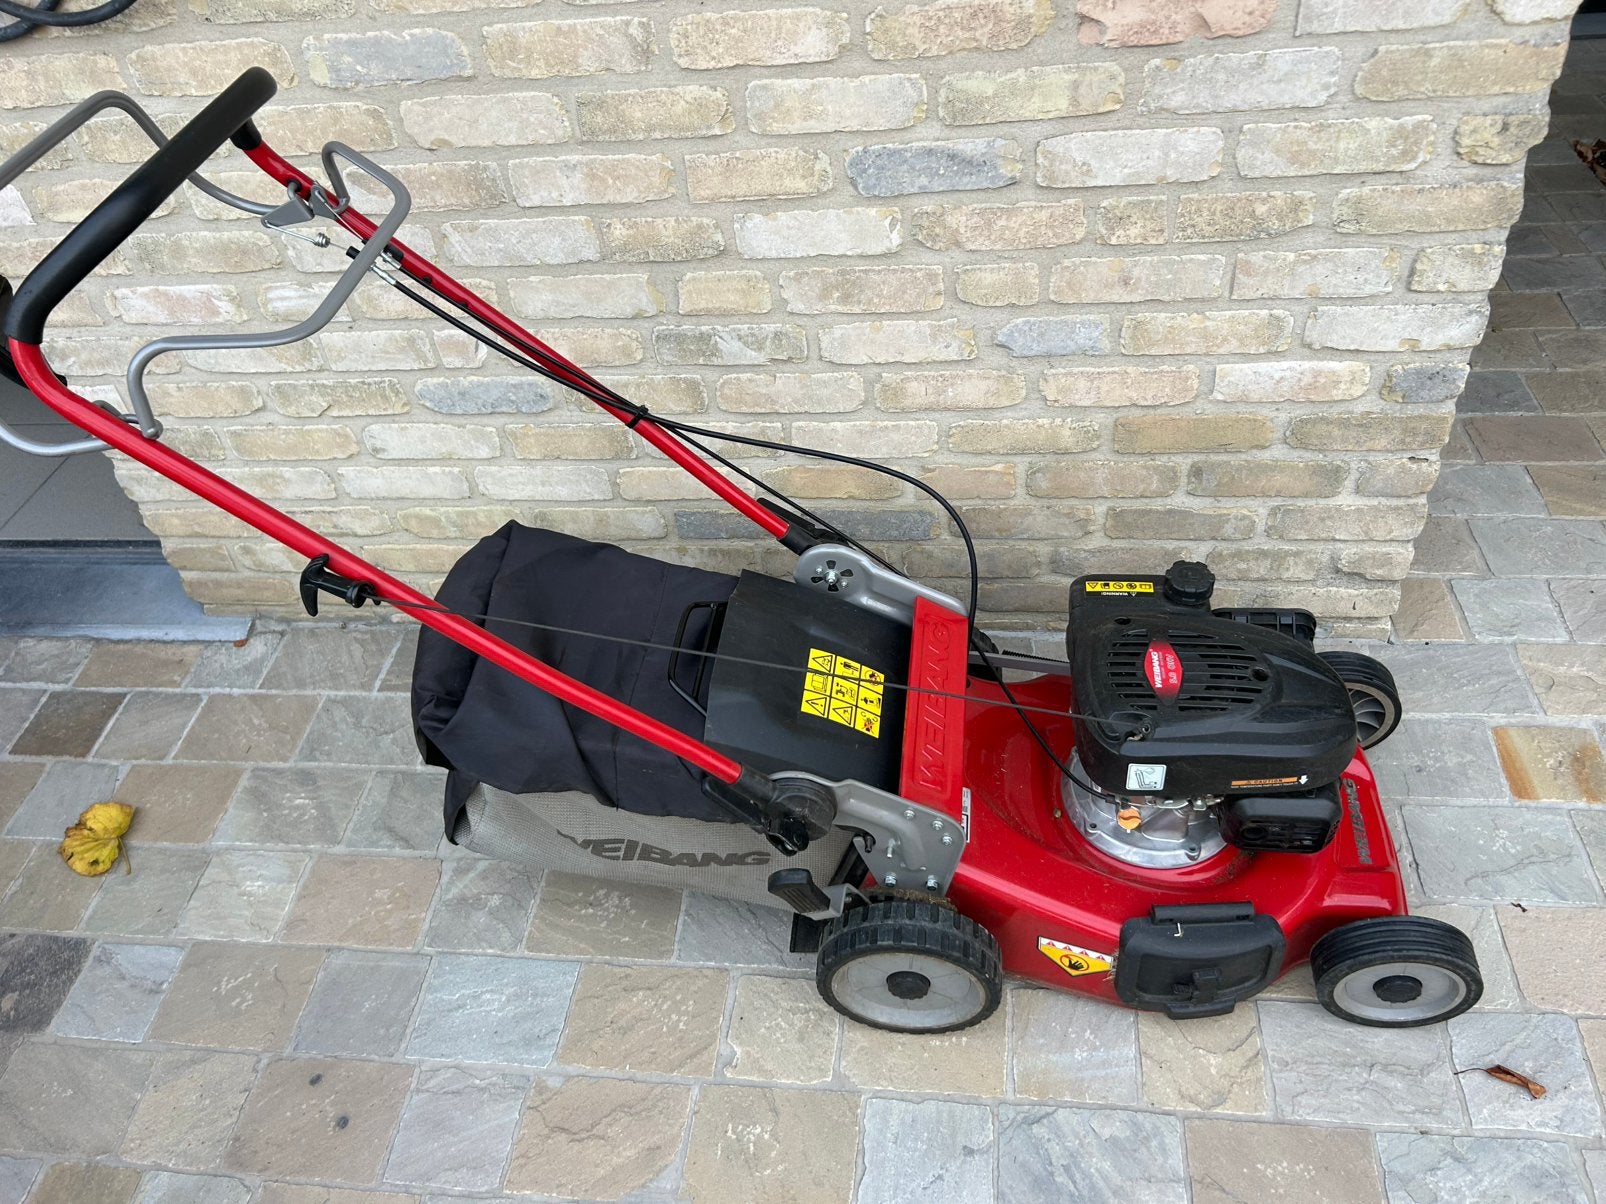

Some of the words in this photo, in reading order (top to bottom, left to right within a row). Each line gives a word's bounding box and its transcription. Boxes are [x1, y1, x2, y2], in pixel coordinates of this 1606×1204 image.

[918, 620, 952, 793] WEIBANG
[1151, 651, 1162, 688] WEIBANG
[1342, 777, 1373, 864] WEIBANG
